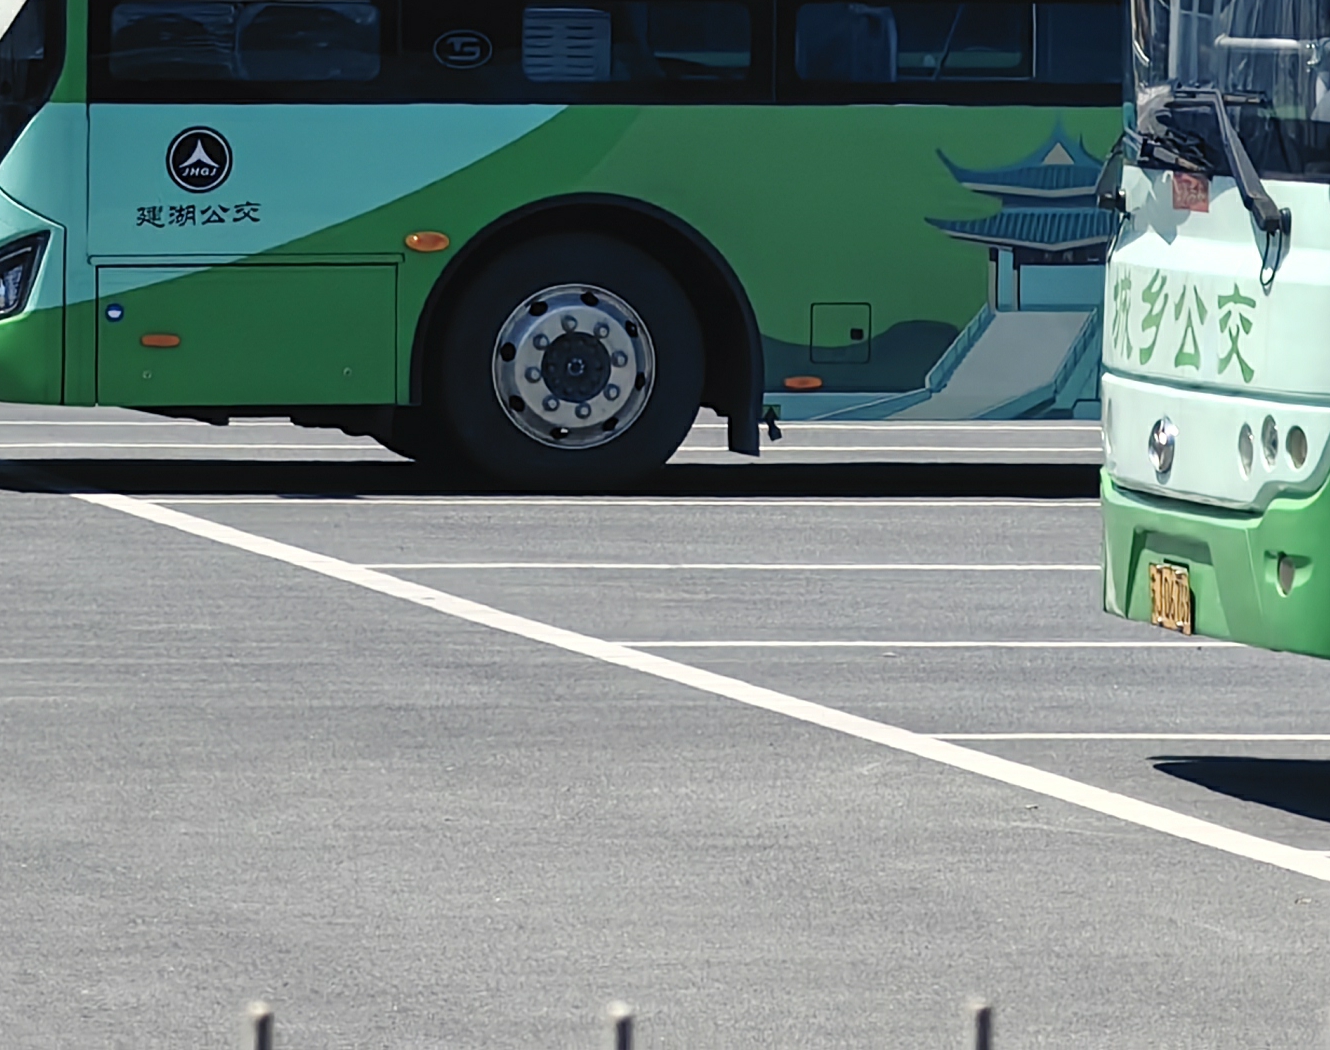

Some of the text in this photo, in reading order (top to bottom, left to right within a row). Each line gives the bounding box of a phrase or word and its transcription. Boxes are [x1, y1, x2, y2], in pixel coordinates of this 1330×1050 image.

[136, 201, 261, 228] 建湖公交
[1112, 266, 1257, 384] 城乡公交
